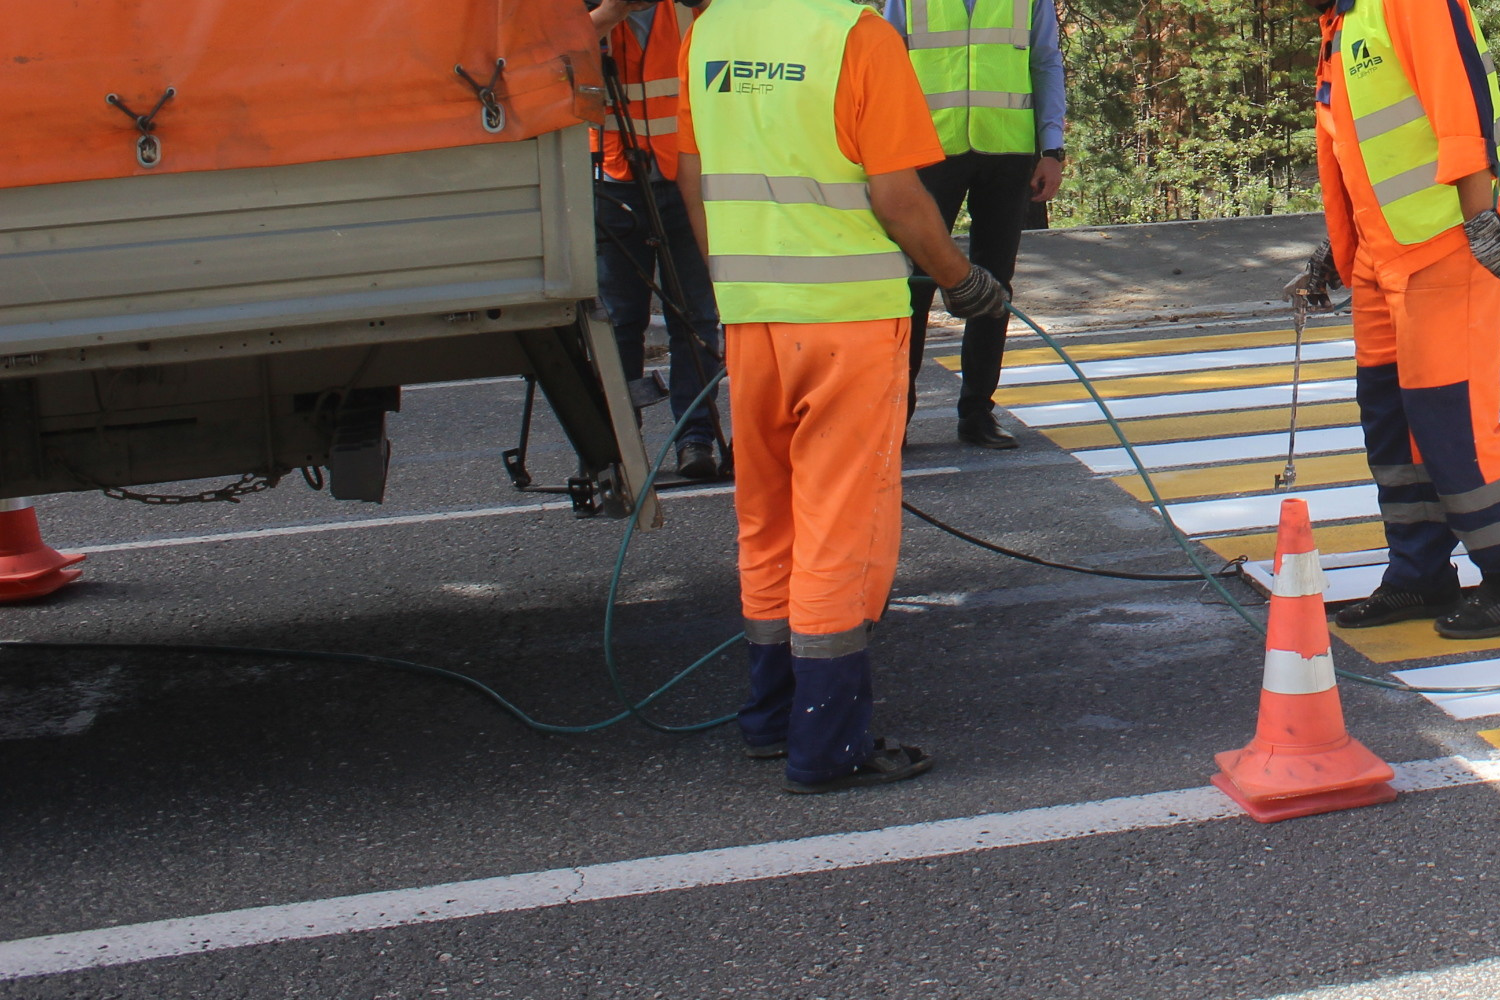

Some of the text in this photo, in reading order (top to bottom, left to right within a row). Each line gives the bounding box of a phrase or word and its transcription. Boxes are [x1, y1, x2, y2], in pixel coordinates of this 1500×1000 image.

[733, 60, 806, 82] БРИЗ
[1349, 55, 1383, 76] БРИЗ
[736, 82, 774, 95] ЦЕНТР
